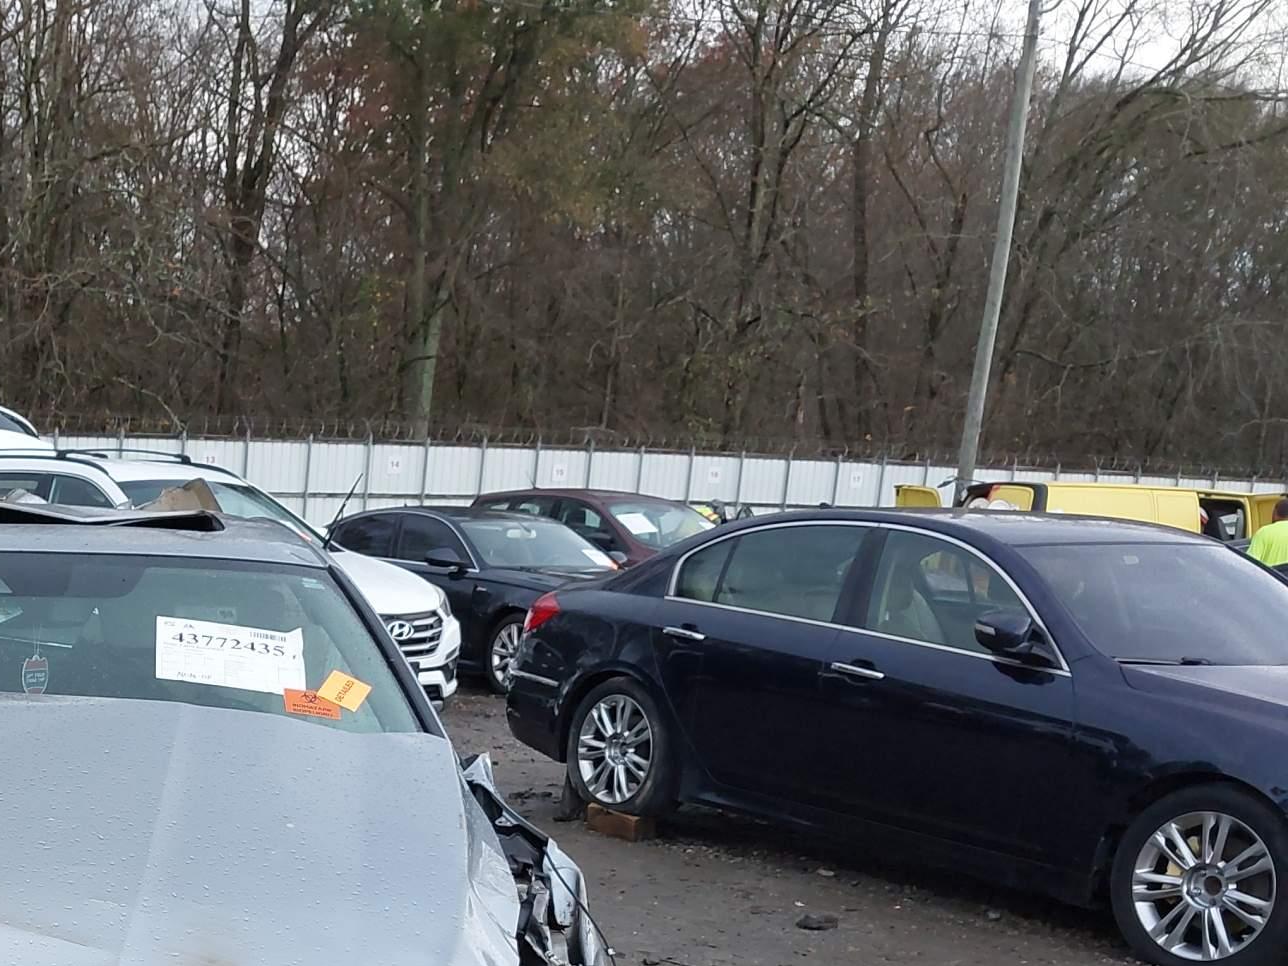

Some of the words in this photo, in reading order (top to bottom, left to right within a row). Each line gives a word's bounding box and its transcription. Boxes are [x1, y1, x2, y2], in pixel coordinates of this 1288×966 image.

[391, 460, 400, 468] 14
[171, 631, 285, 657] 43772435
[334, 680, 354, 702] DETAILED
